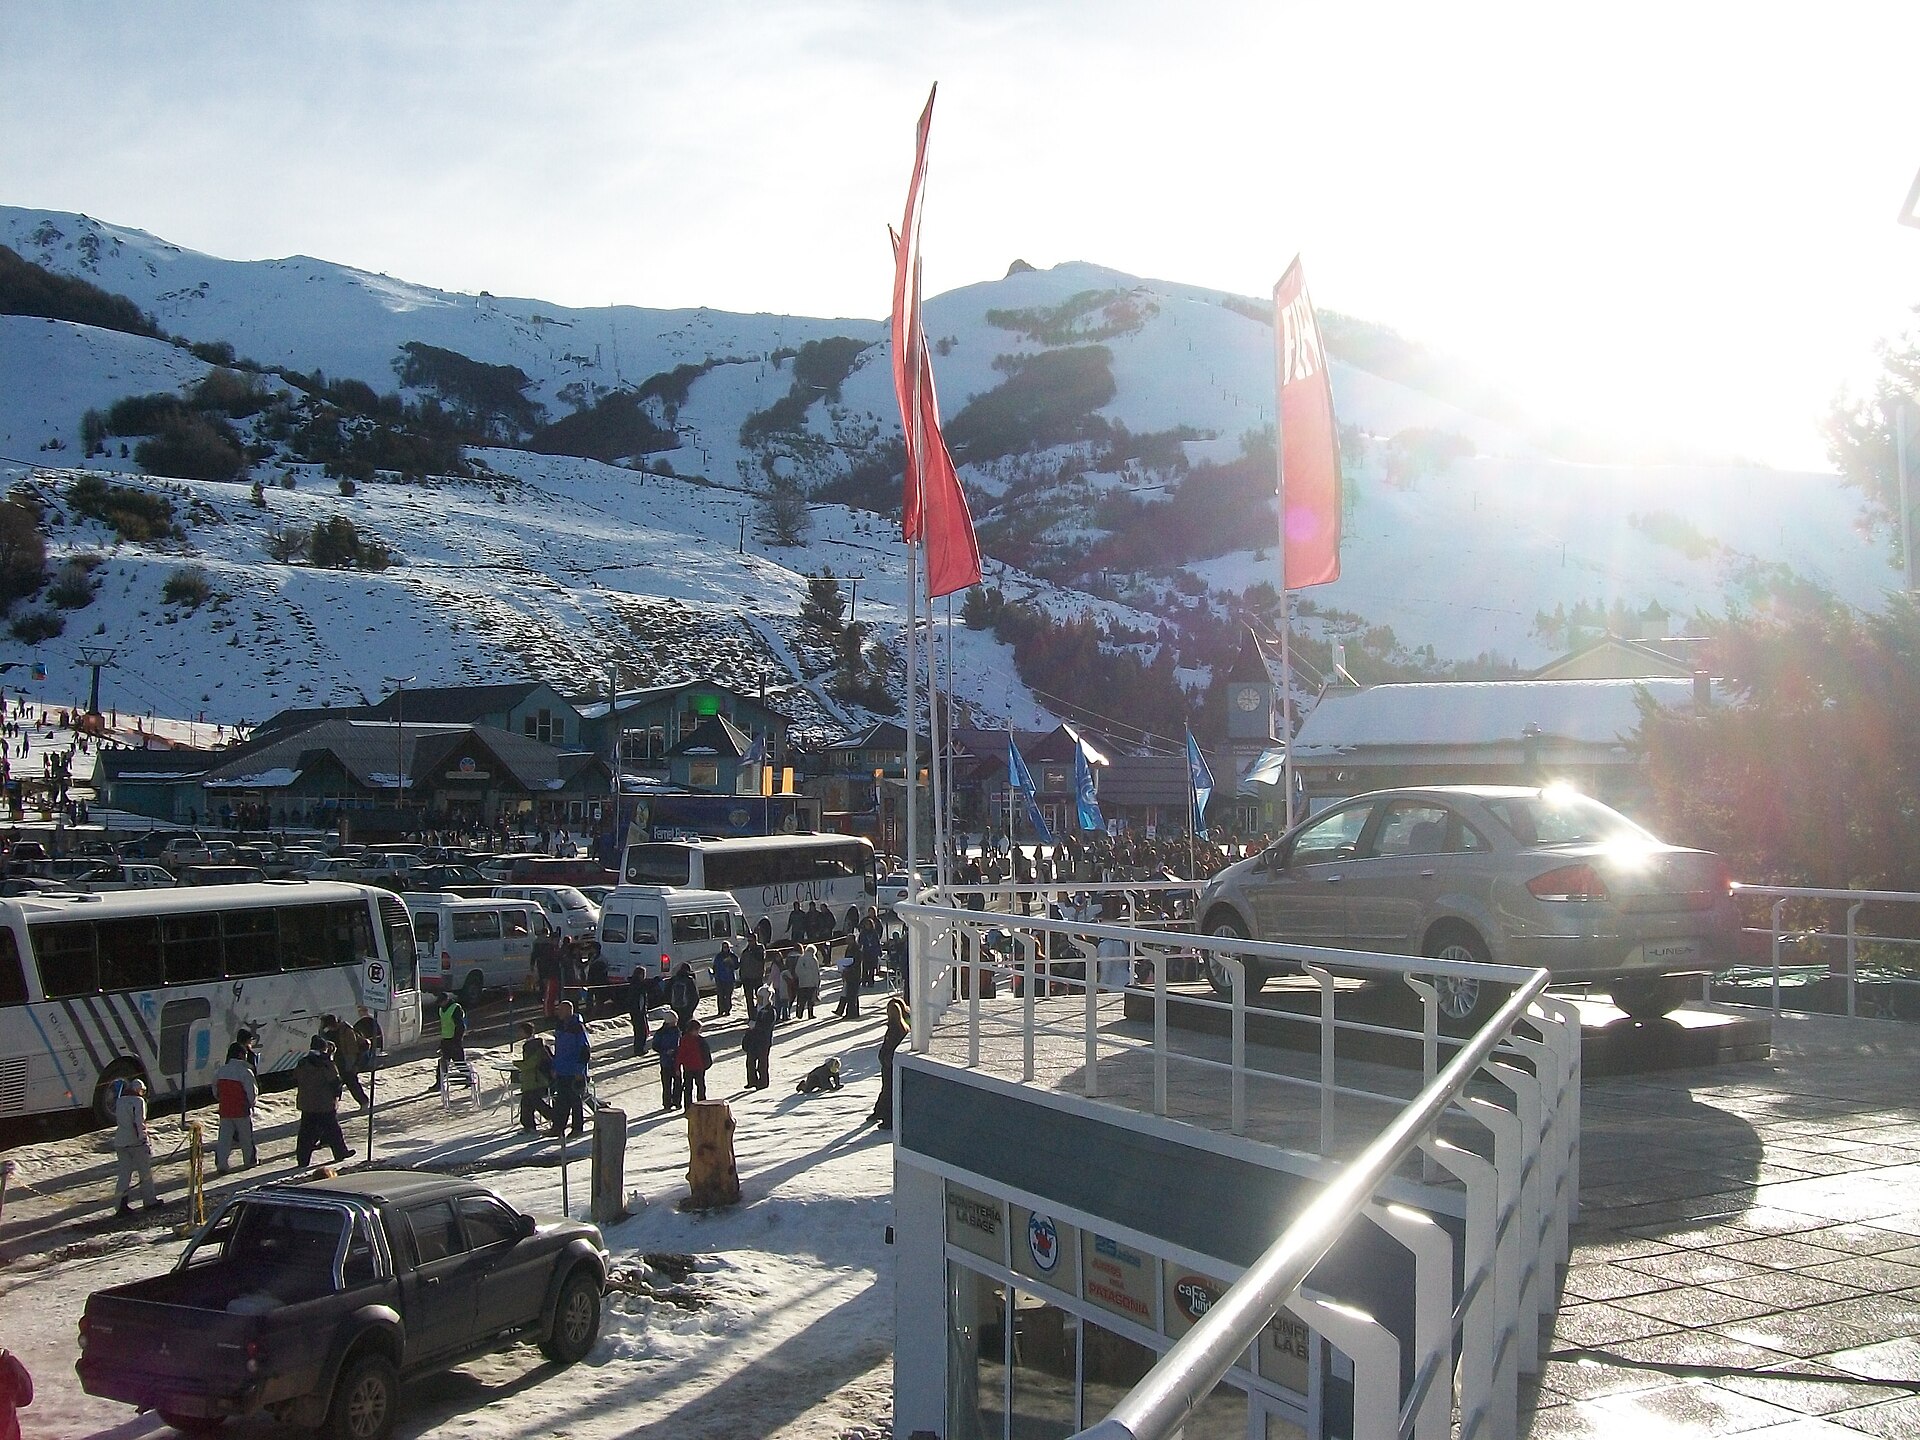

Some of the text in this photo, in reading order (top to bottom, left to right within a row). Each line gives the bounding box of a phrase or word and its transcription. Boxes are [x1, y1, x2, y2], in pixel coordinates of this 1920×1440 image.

[762, 880, 821, 908] CAU CAU
[1088, 1281, 1149, 1314] PATAGONIA
